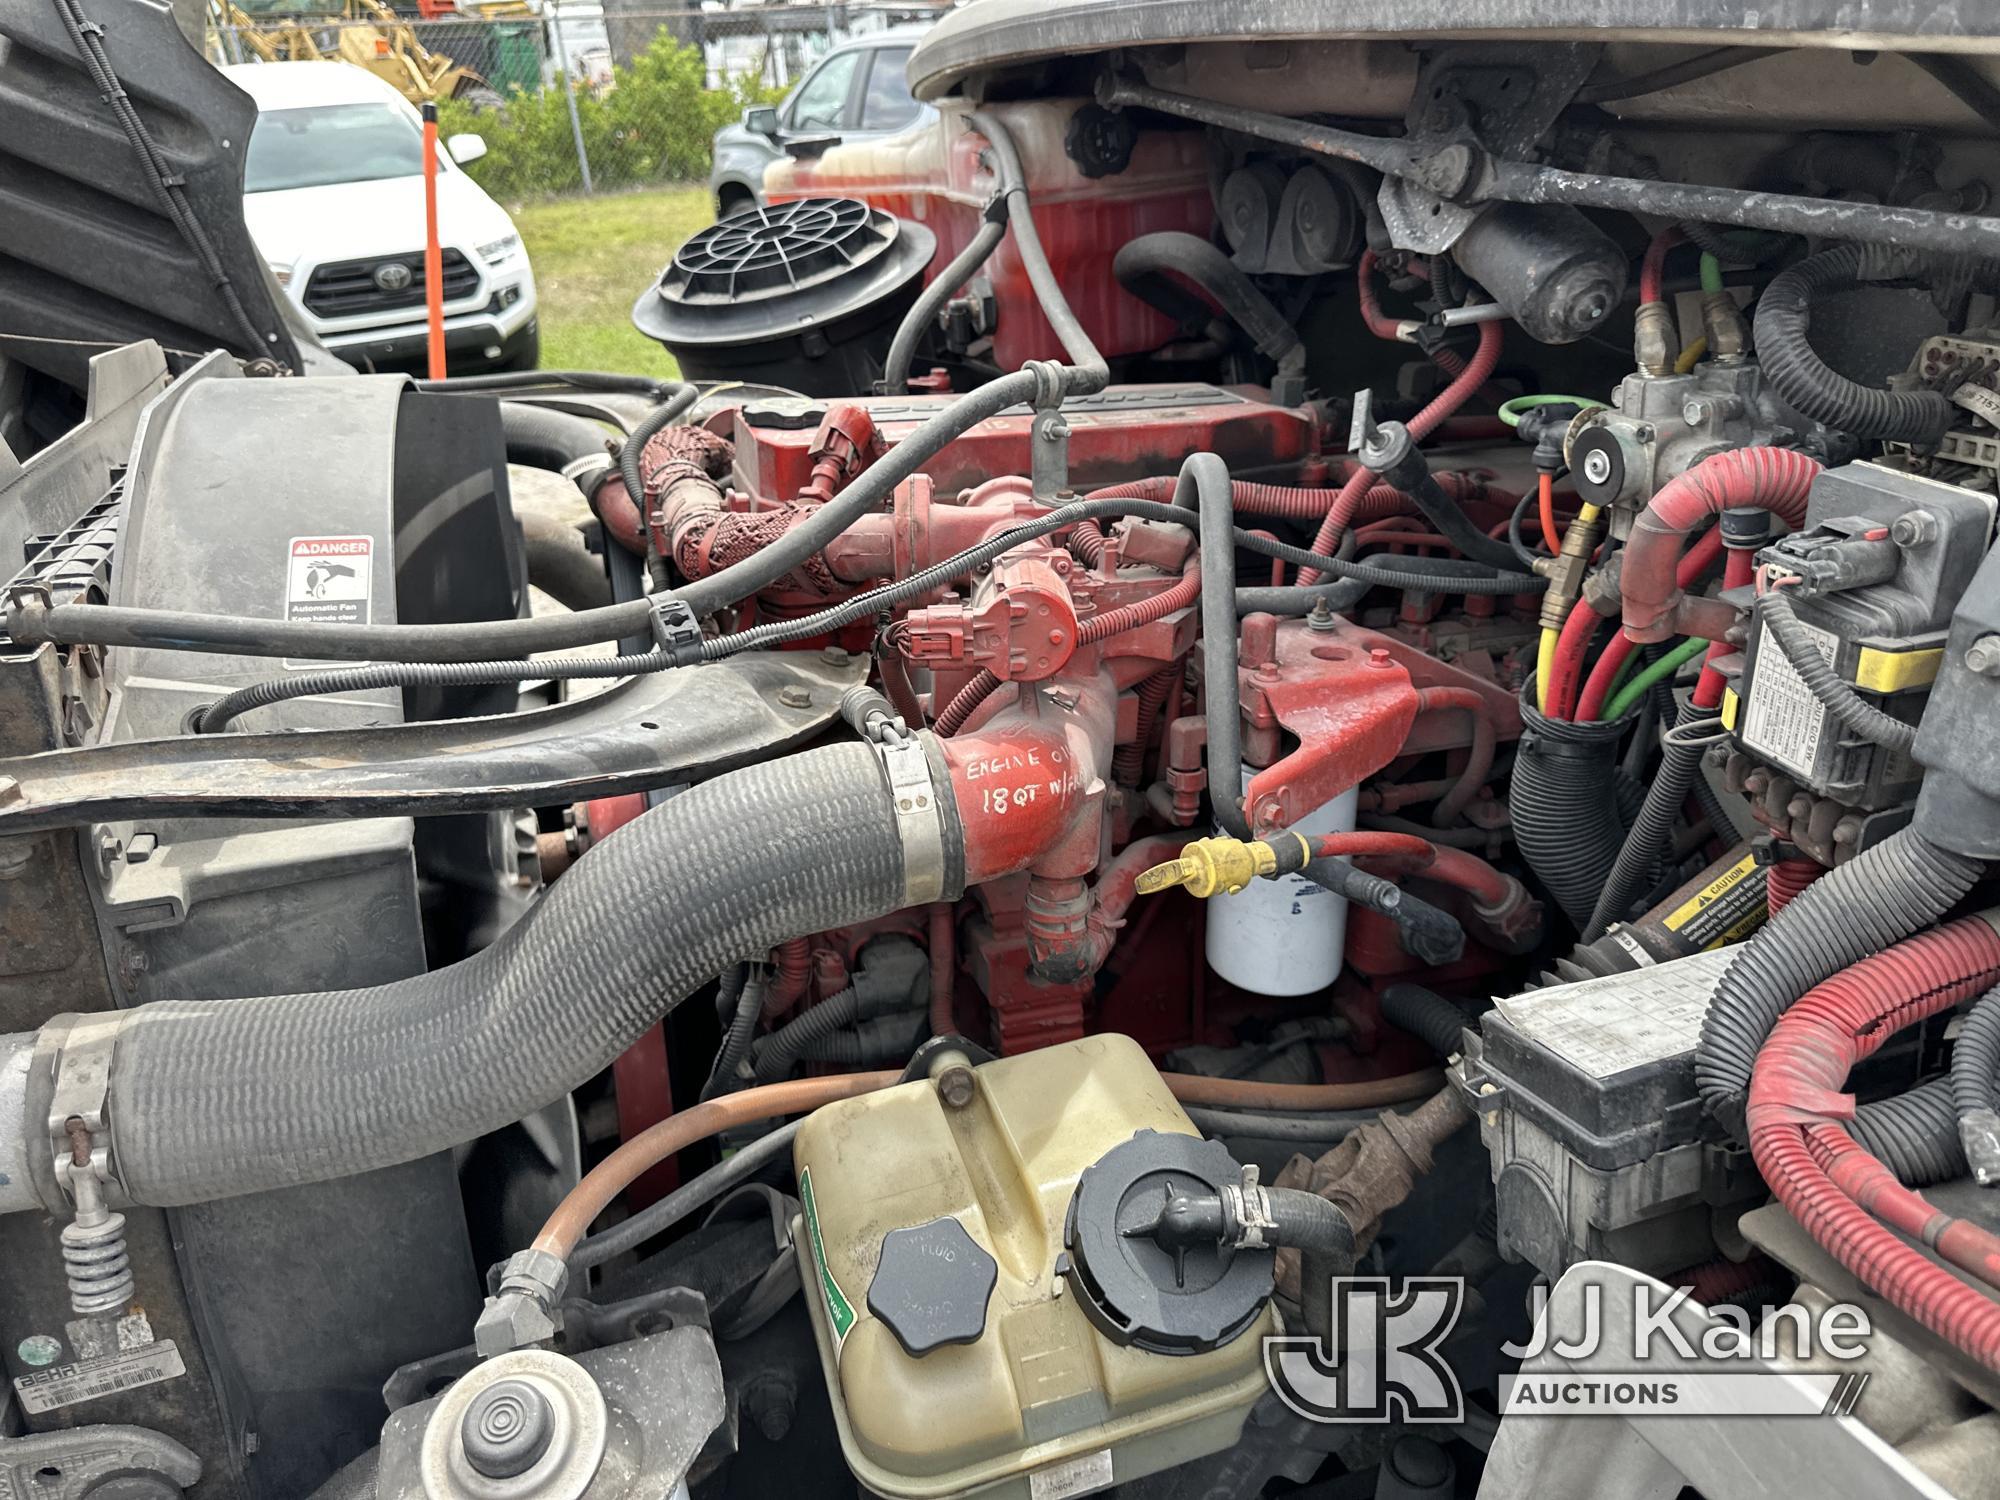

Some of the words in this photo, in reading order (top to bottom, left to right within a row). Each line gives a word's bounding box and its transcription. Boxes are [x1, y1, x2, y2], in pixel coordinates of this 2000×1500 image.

[310, 542, 368, 554] DANGER
[292, 604, 338, 613] Automatic
[339, 603, 357, 611] Fan
[967, 747, 1040, 779] ENGINE
[1805, 745, 1813, 762] SW
[1710, 866, 1744, 894] CAUTION
[20, 1364, 77, 1386] BEHR
